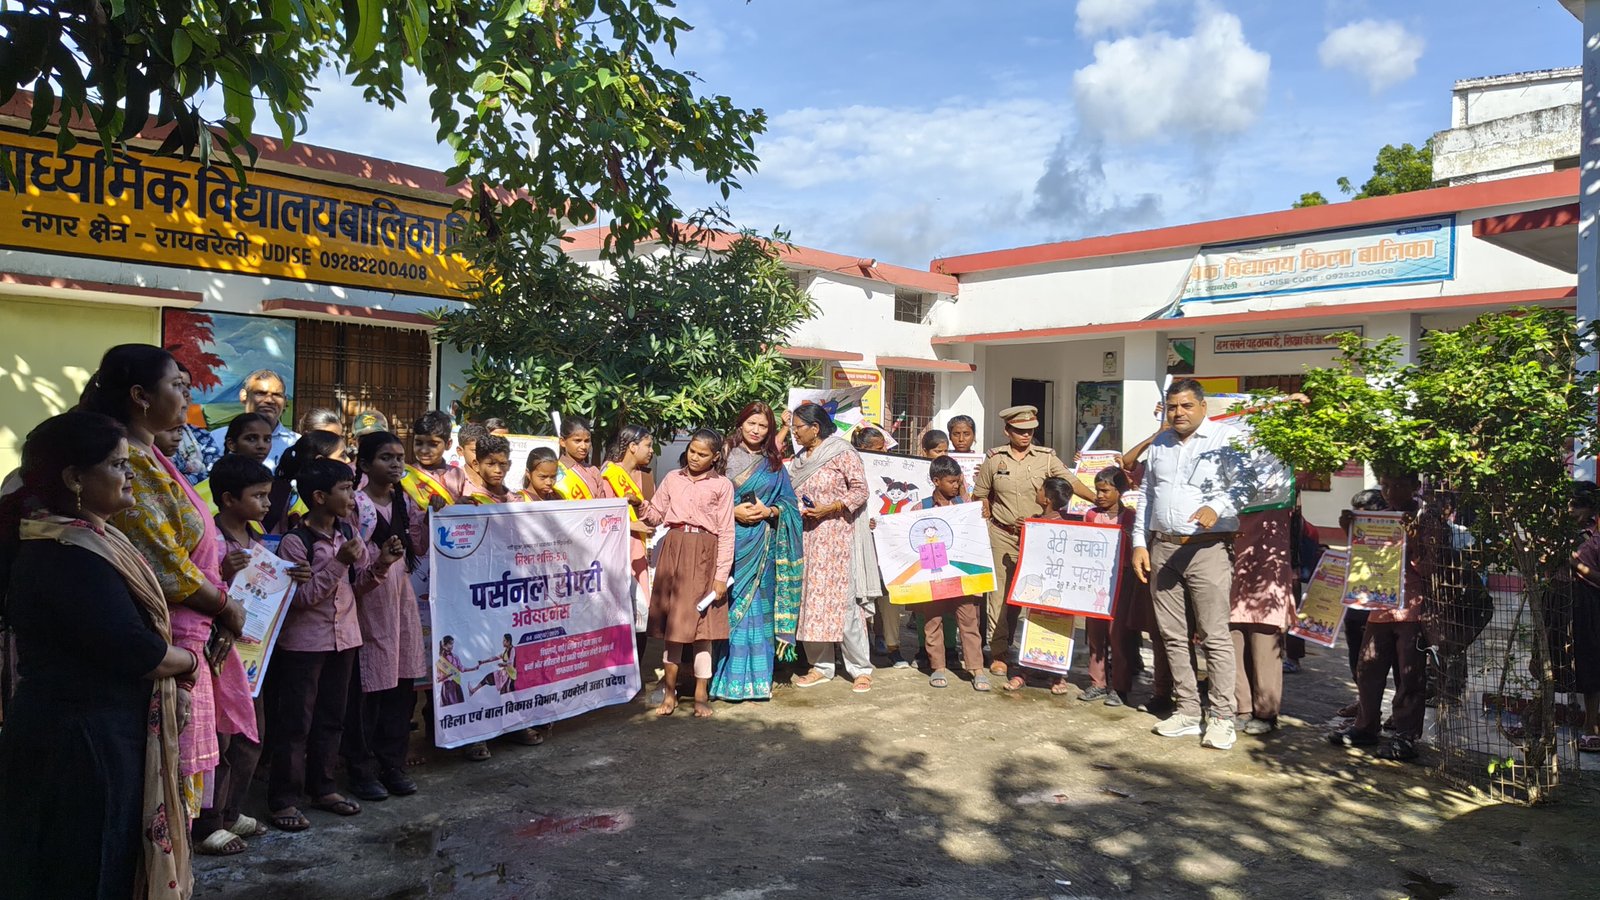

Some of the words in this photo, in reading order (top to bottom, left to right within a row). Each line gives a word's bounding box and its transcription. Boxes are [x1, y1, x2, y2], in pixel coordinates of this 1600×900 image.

[22, 210, 80, 238] नगर
[89, 213, 130, 244] क्षेत्र
[262, 243, 312, 266] UDISE
[319, 250, 428, 281] 09282200408
[1223, 256, 1295, 280] विद्यालय
[1300, 248, 1353, 271] किला
[1357, 238, 1436, 264] बालिका
[1259, 277, 1290, 287] U-DISE
[1292, 274, 1319, 285] CODE
[1326, 267, 1395, 281] 09282200408
[1047, 529, 1068, 554] बेटी
[1073, 531, 1109, 558] बचाओ
[470, 570, 549, 610] पर्सनल
[553, 560, 603, 598] सेफ्टी
[1044, 556, 1065, 579] बेटी
[468, 706, 483, 724] एवं
[485, 704, 503, 720] बाल
[505, 697, 533, 715] विकास
[534, 692, 560, 709] विभाग,
[589, 679, 604, 694] उत्तर
[605, 673, 626, 688] प्रदेश
